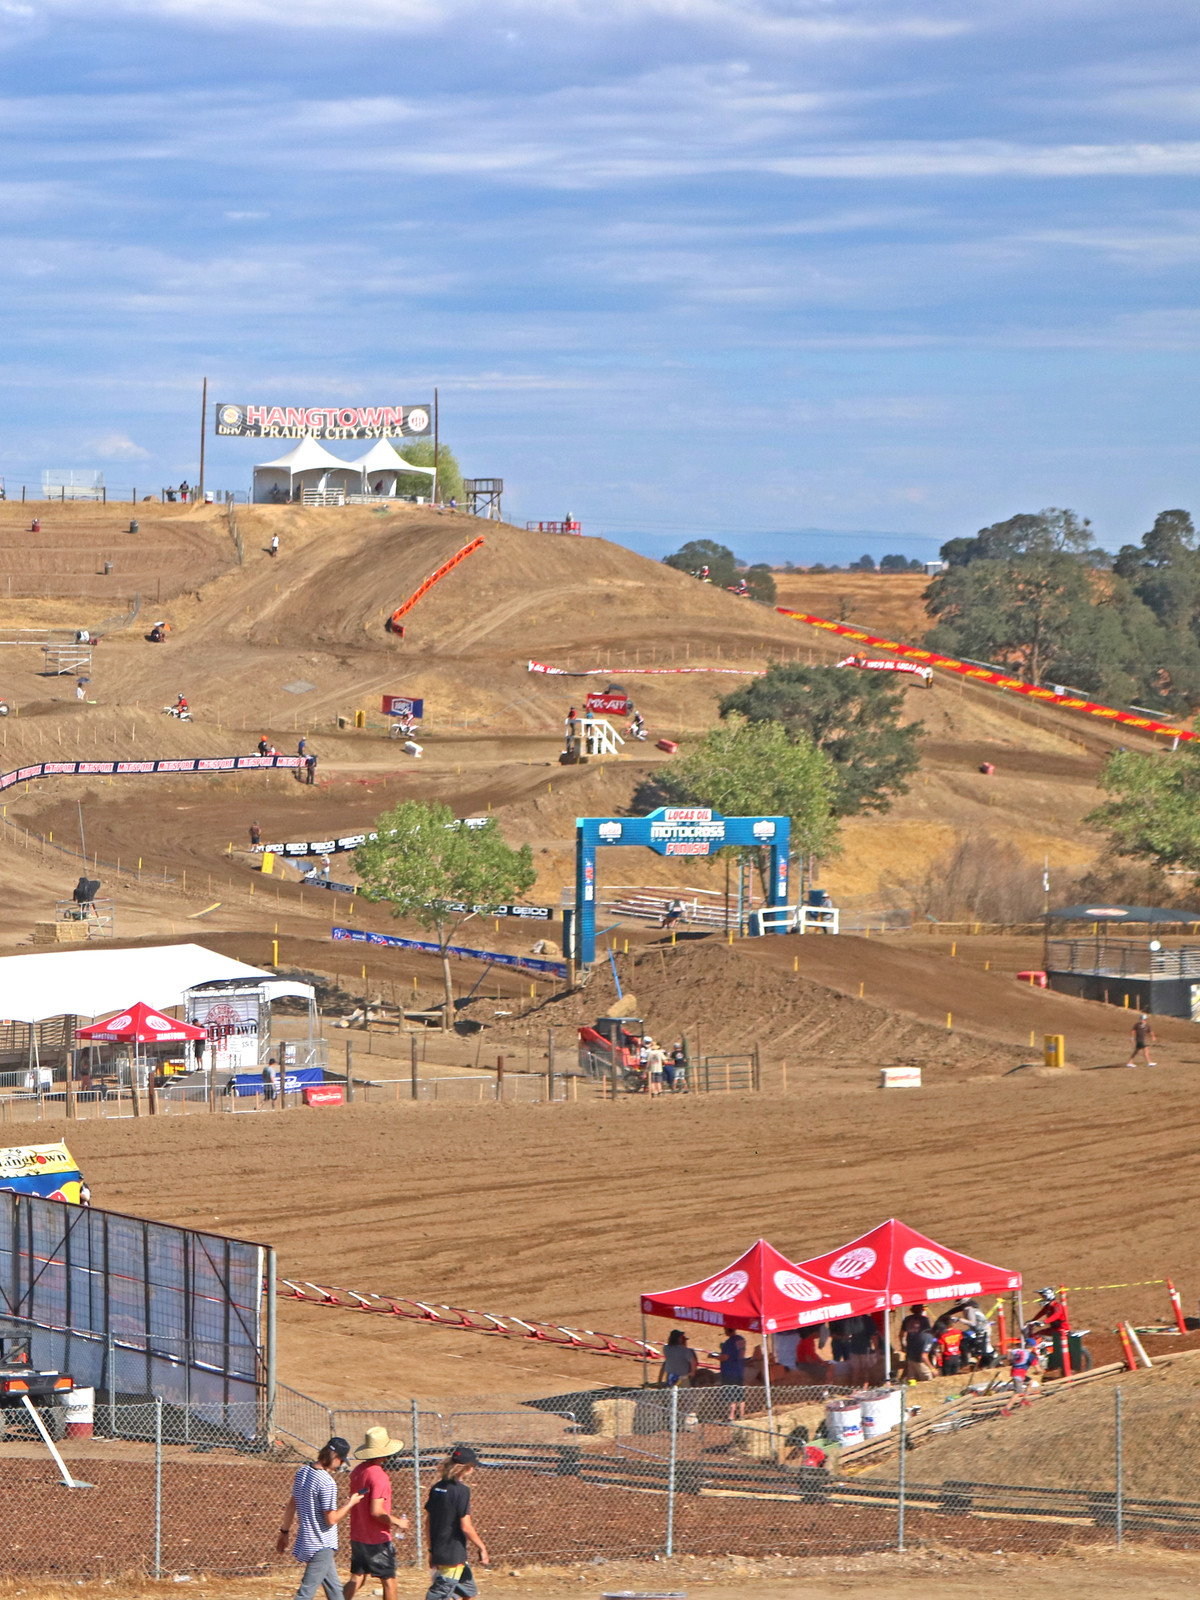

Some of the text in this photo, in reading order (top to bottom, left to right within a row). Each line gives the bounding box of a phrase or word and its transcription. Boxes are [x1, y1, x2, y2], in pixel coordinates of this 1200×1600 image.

[246, 405, 404, 427] HANGTOWN
[260, 425, 321, 439] PRAIRIE
[325, 426, 361, 439] CITY
[364, 426, 404, 439] SVRA
[668, 811, 709, 820] LUCAS OIL
[651, 826, 725, 838] MOTOCROSS
[286, 843, 308, 852] GEICO
[311, 840, 336, 850] GEICO
[666, 842, 710, 856] FINISH
[304, 877, 326, 888] GEICO
[512, 906, 548, 916] GEICO
[926, 1282, 982, 1300] HANGTOWN
[673, 1306, 725, 1326] HANGTOWN
[799, 1303, 853, 1325] HANGTOWN
